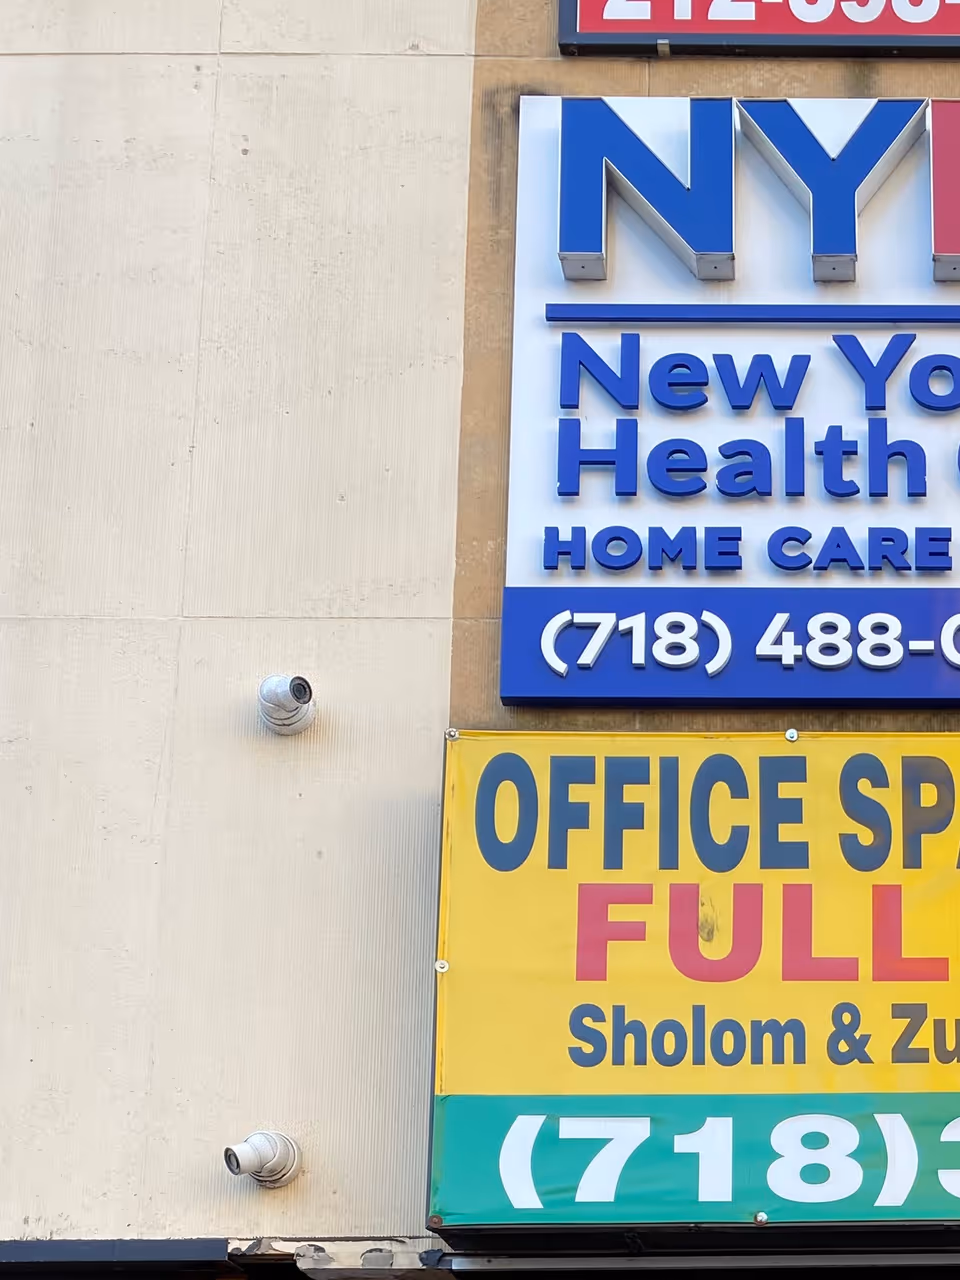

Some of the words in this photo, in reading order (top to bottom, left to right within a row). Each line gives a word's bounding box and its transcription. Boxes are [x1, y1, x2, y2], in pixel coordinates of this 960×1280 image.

[560, 332, 811, 411] New
[557, 417, 927, 498] Health
[543, 526, 742, 571] HOME
[767, 526, 952, 571] CARE
[540, 609, 732, 678] (718)
[475, 752, 810, 873] OFFICE
[575, 882, 950, 983] FULL
[567, 1003, 806, 1067] Sholom
[826, 1002, 873, 1065] &
